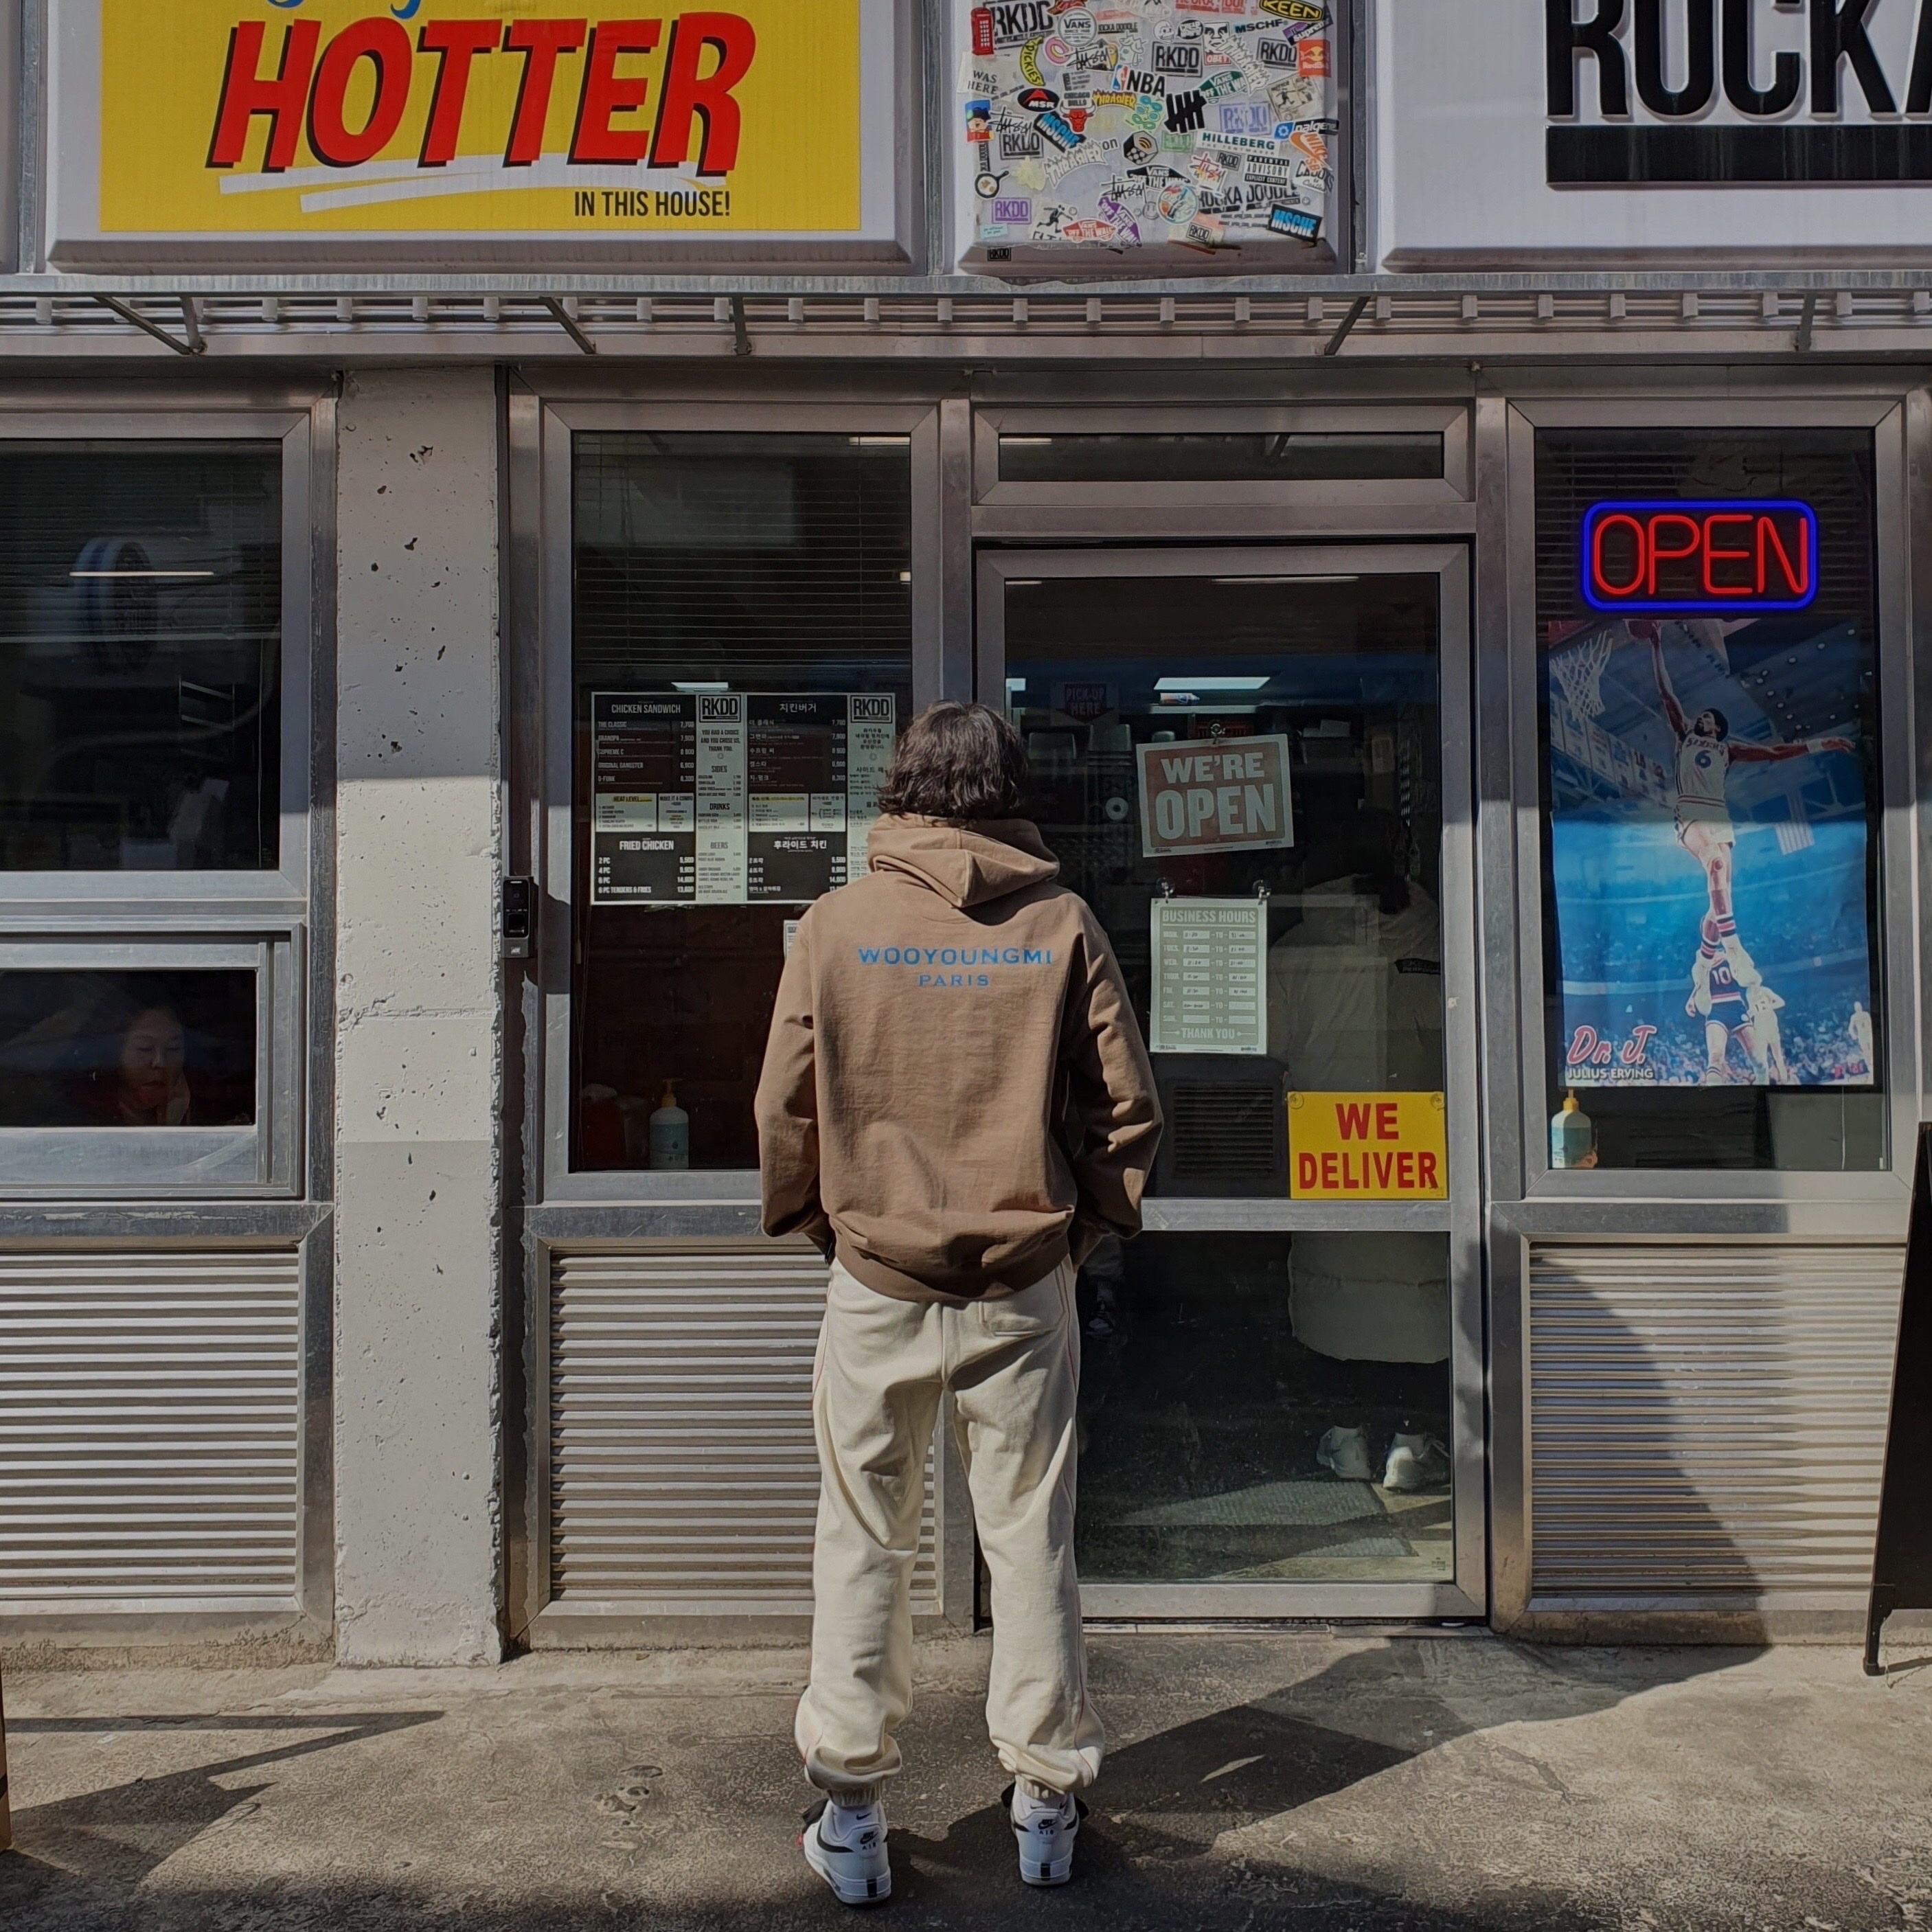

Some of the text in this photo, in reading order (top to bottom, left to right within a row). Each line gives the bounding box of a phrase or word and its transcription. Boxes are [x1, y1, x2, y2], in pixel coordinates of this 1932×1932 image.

[1264, 0, 1319, 18] KEEN
[993, 1, 1053, 36] RKDD
[1064, 19, 1091, 29] VANS
[1023, 44, 1041, 84] DICKIES
[1155, 45, 1199, 68] RKDD
[1547, 0, 1932, 115] ROCK
[973, 70, 997, 83] WAS
[1126, 70, 1165, 98] NBA
[1209, 71, 1233, 87] VANS
[205, 12, 756, 177] HOTTER
[968, 81, 998, 94] HERE
[1028, 100, 1055, 109] MSR
[1093, 89, 1137, 110] THRASHER
[1102, 139, 1118, 150] on
[1203, 133, 1275, 150] HILLEBERG
[1218, 152, 1239, 166] RKDD
[1247, 155, 1288, 166] PARENTAL
[1146, 166, 1170, 177] VANS
[1247, 163, 1287, 177] ADVISORY
[574, 191, 731, 217] IN THIS HOUSE!
[996, 201, 1028, 217] RKDD
[1271, 209, 1317, 238] MSCHF
[1189, 225, 1209, 240] RKDD
[1593, 514, 1808, 595] OPEN
[1066, 687, 1106, 701] PICK-UP
[611, 704, 681, 714] CHICKEN SANDWICH
[702, 698, 738, 716] RKDD
[779, 703, 817, 713] 치킨버거
[854, 698, 889, 716] RKDD
[1070, 702, 1102, 715] HERE
[1694, 749, 1712, 769] 6
[1155, 783, 1277, 840] OPEN
[620, 840, 674, 851] FRIED CHICKEN
[773, 840, 827, 850] 후라이드 치킨
[1162, 910, 1256, 923] BUSINESS HOURS
[859, 946, 1052, 966] WOOYOUNGMI
[918, 974, 989, 987] PARIS
[1712, 968, 1731, 984] 10
[1181, 1027, 1236, 1039] THANK YOU
[1567, 1025, 1612, 1065] Dr.
[1567, 1068, 1654, 1080] JULIUS ERVING
[1335, 1103, 1399, 1140] WE
[1299, 1151, 1439, 1190] DELIVER
